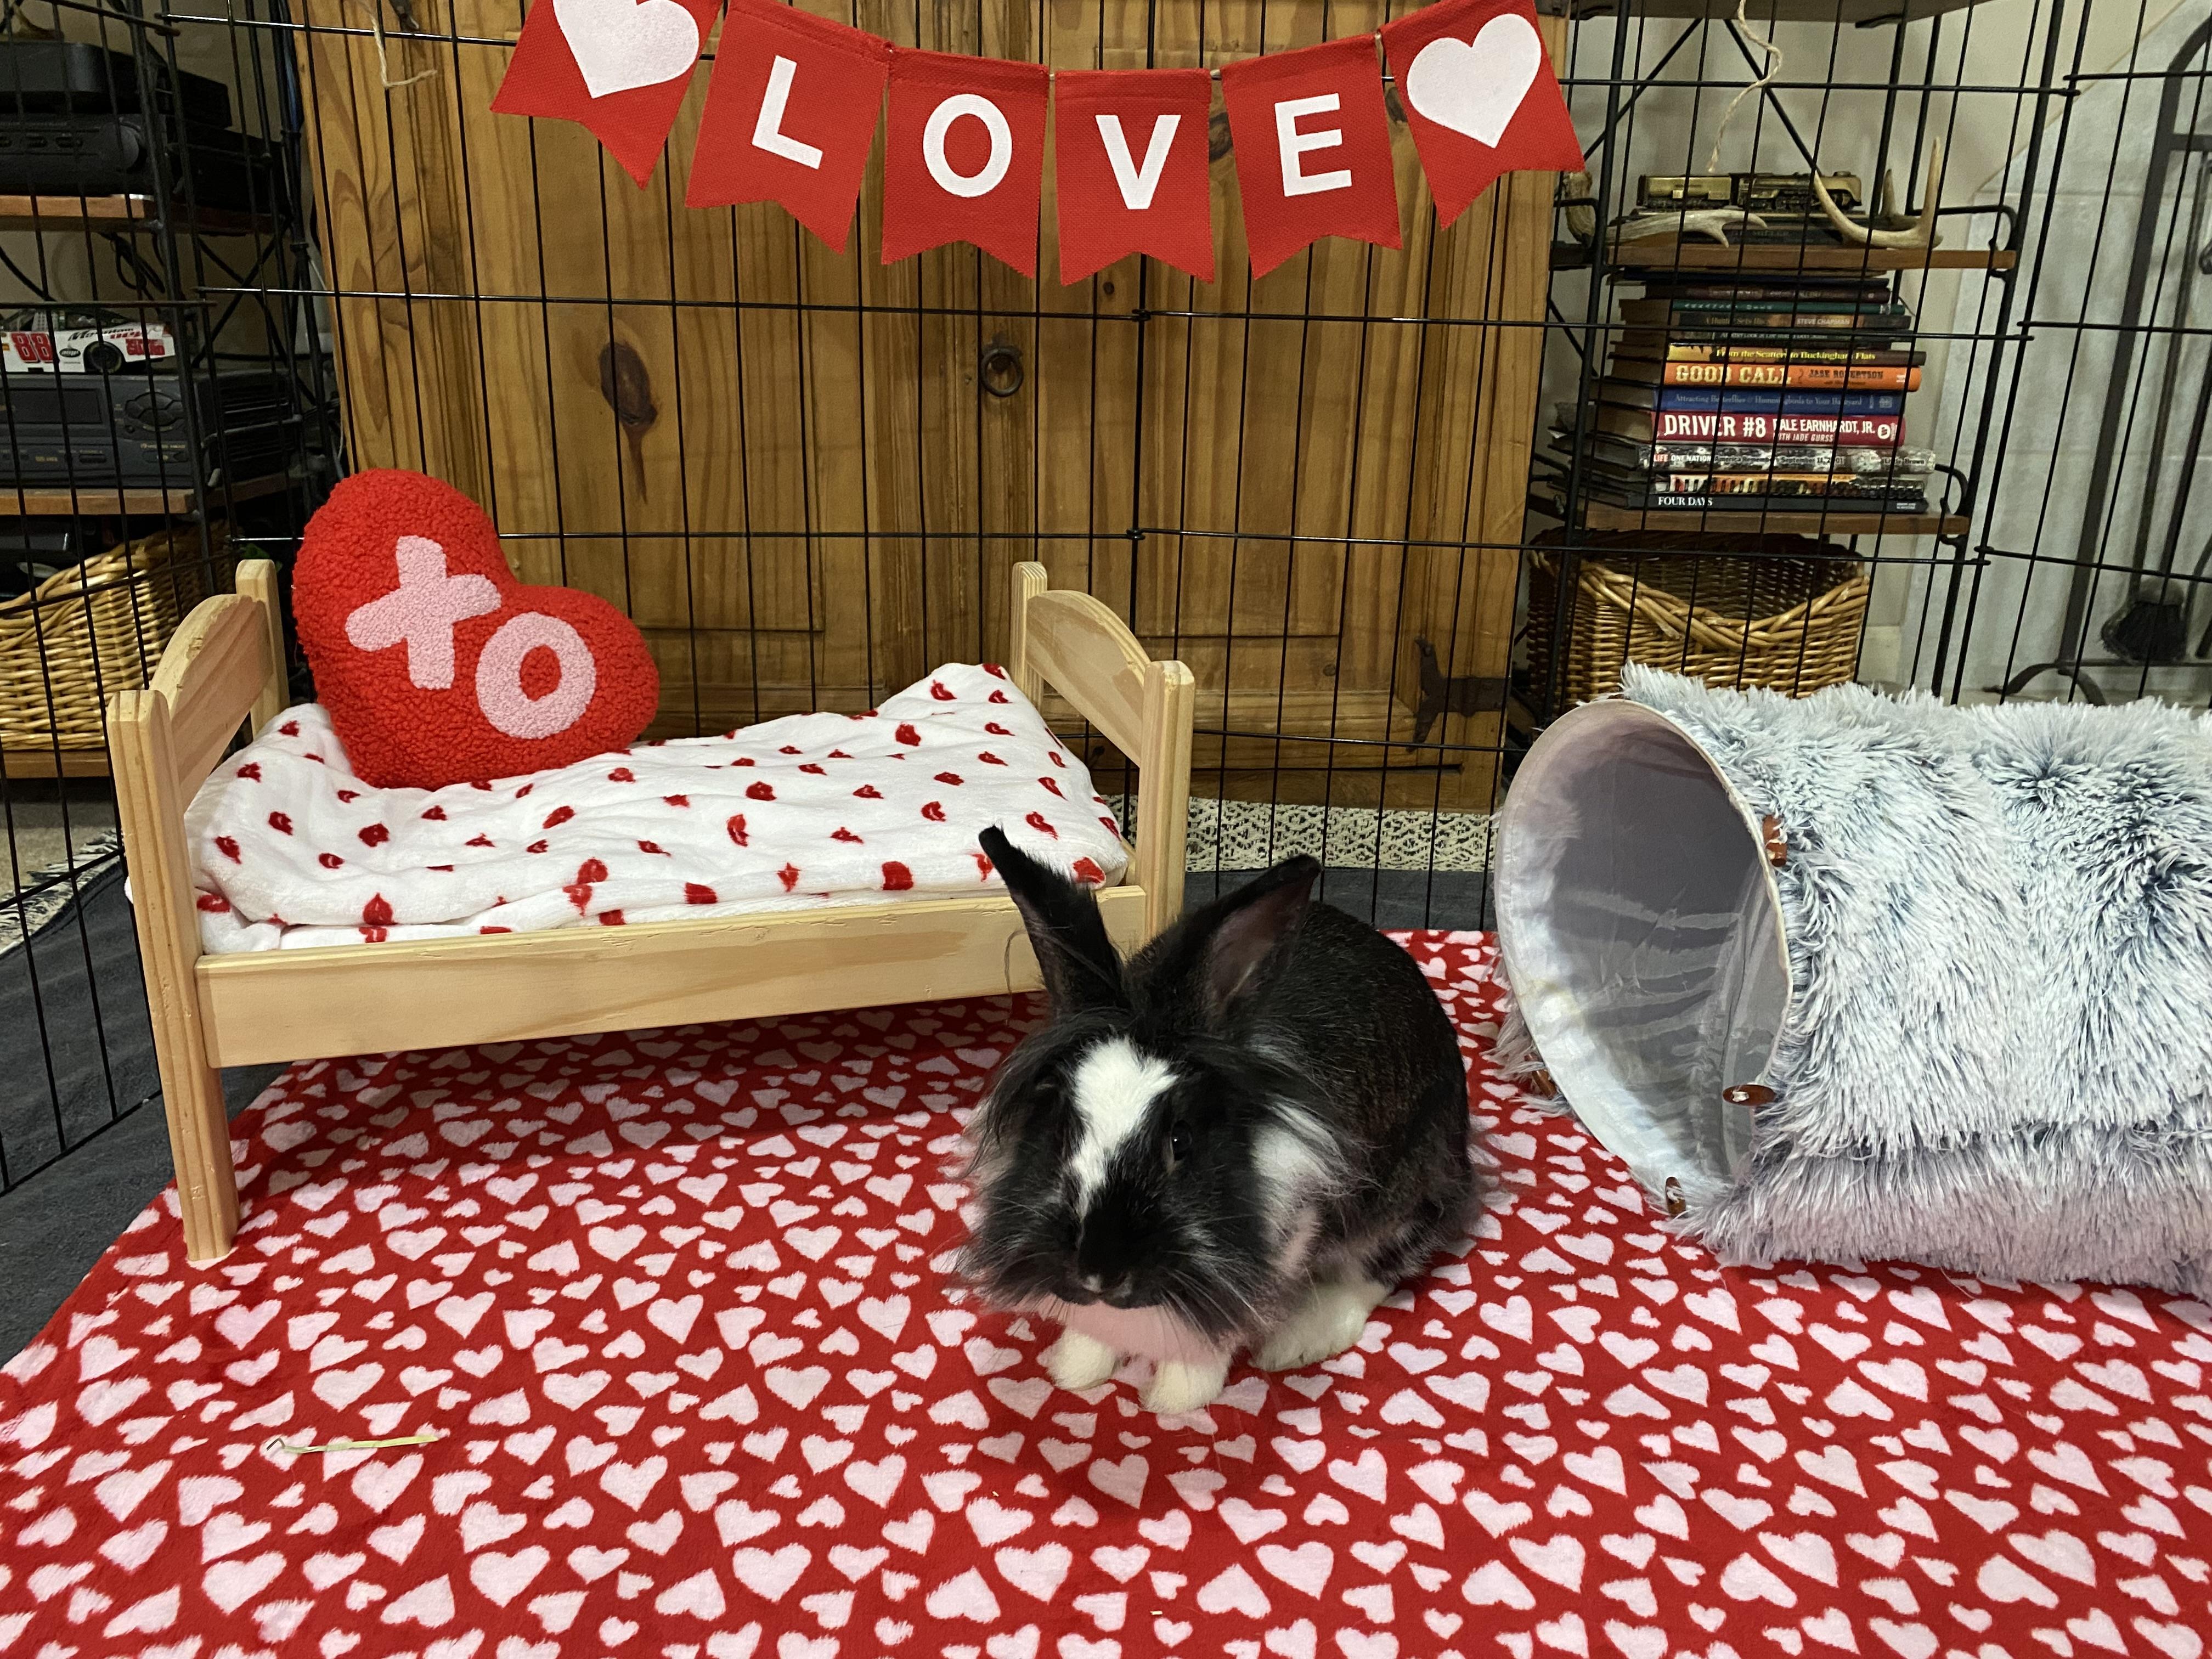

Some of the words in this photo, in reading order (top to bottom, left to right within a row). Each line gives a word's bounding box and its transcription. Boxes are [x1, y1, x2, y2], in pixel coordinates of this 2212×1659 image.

[752, 55, 1352, 210] LOVE
[11, 332, 54, 363] 88
[1675, 365, 1731, 383] GOOD
[1739, 366, 1792, 385] CALL
[1833, 370, 1883, 379] ROERTSON
[1711, 394, 1746, 403] Buterflies
[1755, 394, 1805, 405] Hummigbirds
[1664, 414, 1736, 437] DRIVER
[1742, 416, 1766, 438] #8
[1773, 418, 1798, 431] DALE
[1800, 419, 1860, 435] EARNHARDT,
[1861, 420, 1876, 434] JR.
[1792, 433, 1809, 442] JADE
[1810, 434, 1833, 442] GURSS
[1653, 454, 1668, 462] LIFE
[1658, 496, 1686, 506] FOUR
[1688, 496, 1713, 506] DAYS
